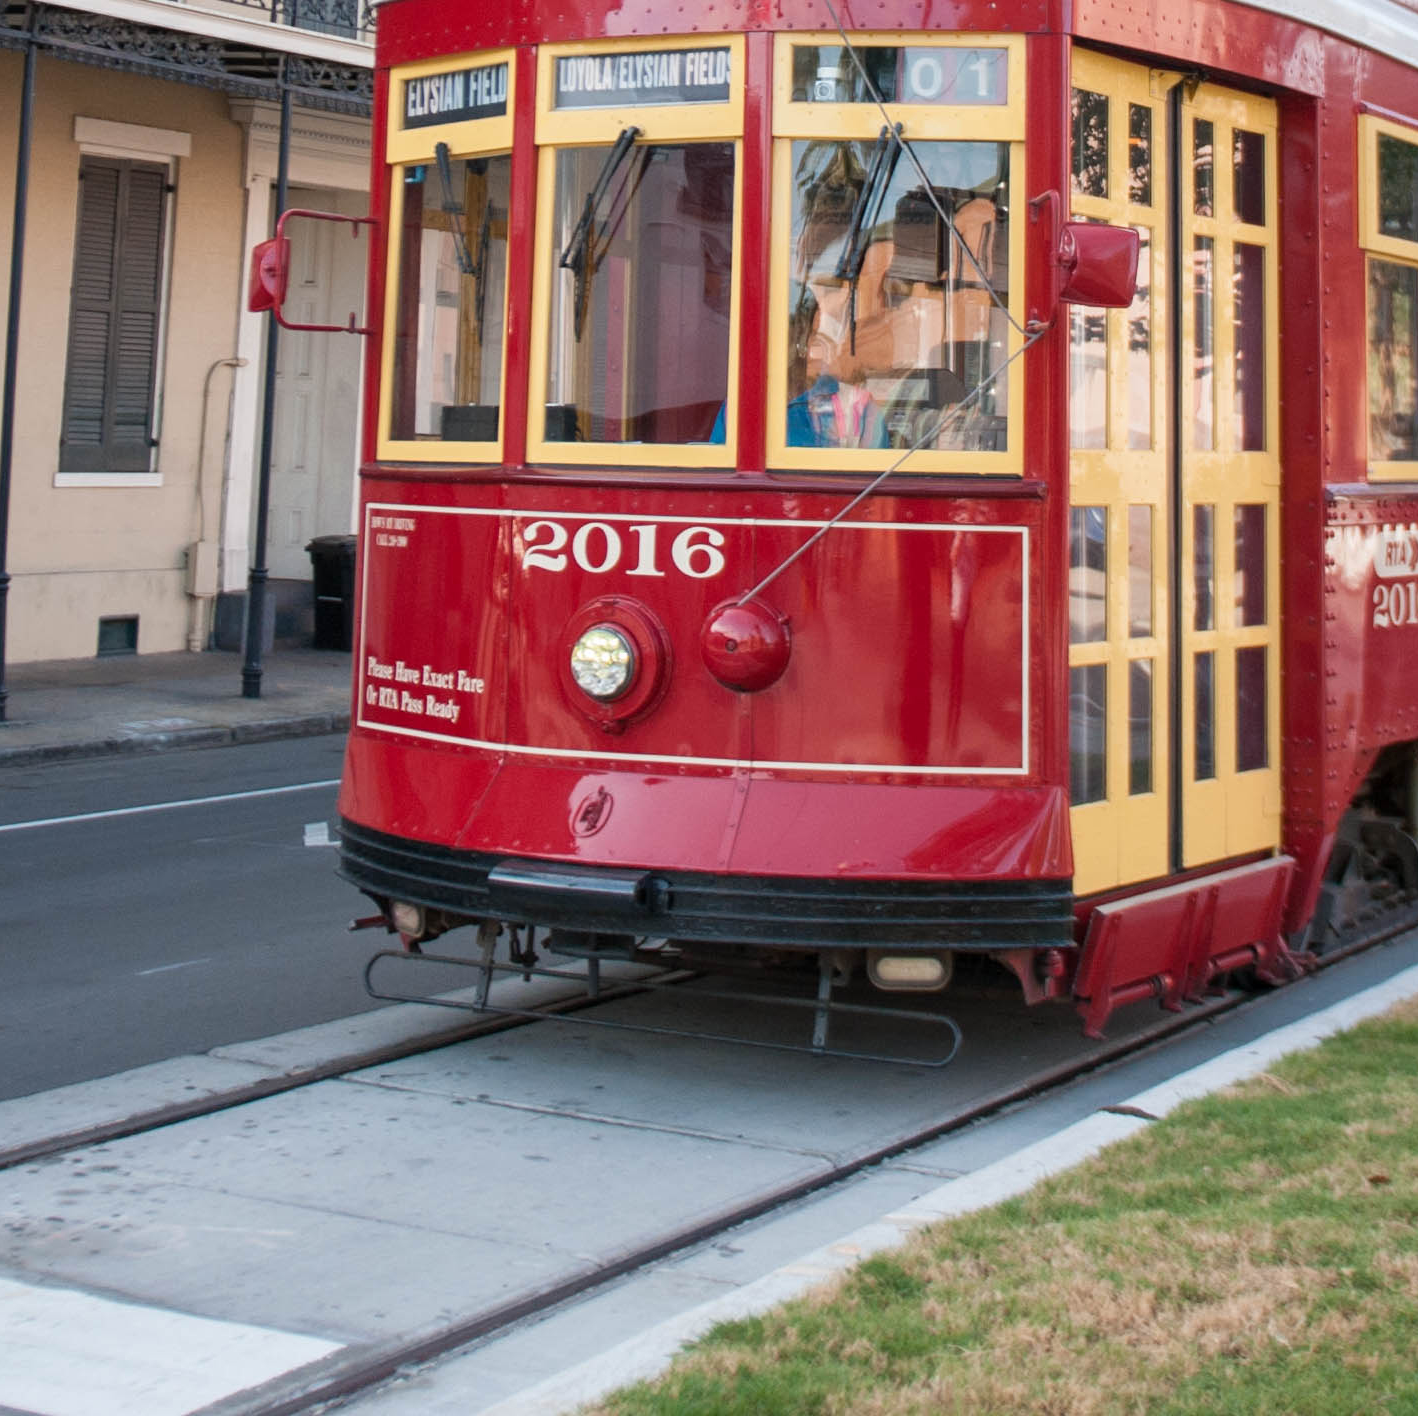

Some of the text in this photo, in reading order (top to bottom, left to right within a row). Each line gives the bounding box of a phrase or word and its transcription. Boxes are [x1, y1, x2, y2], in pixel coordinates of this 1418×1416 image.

[560, 53, 680, 92] LOYOLA/ELYSIAN
[407, 72, 464, 117] ELYSIAN
[522, 520, 725, 579] 2016
[1385, 541, 1406, 567] RTA
[368, 656, 484, 694] Please Have Exact Fare
[366, 684, 460, 723] Or RTA Pass Ready
